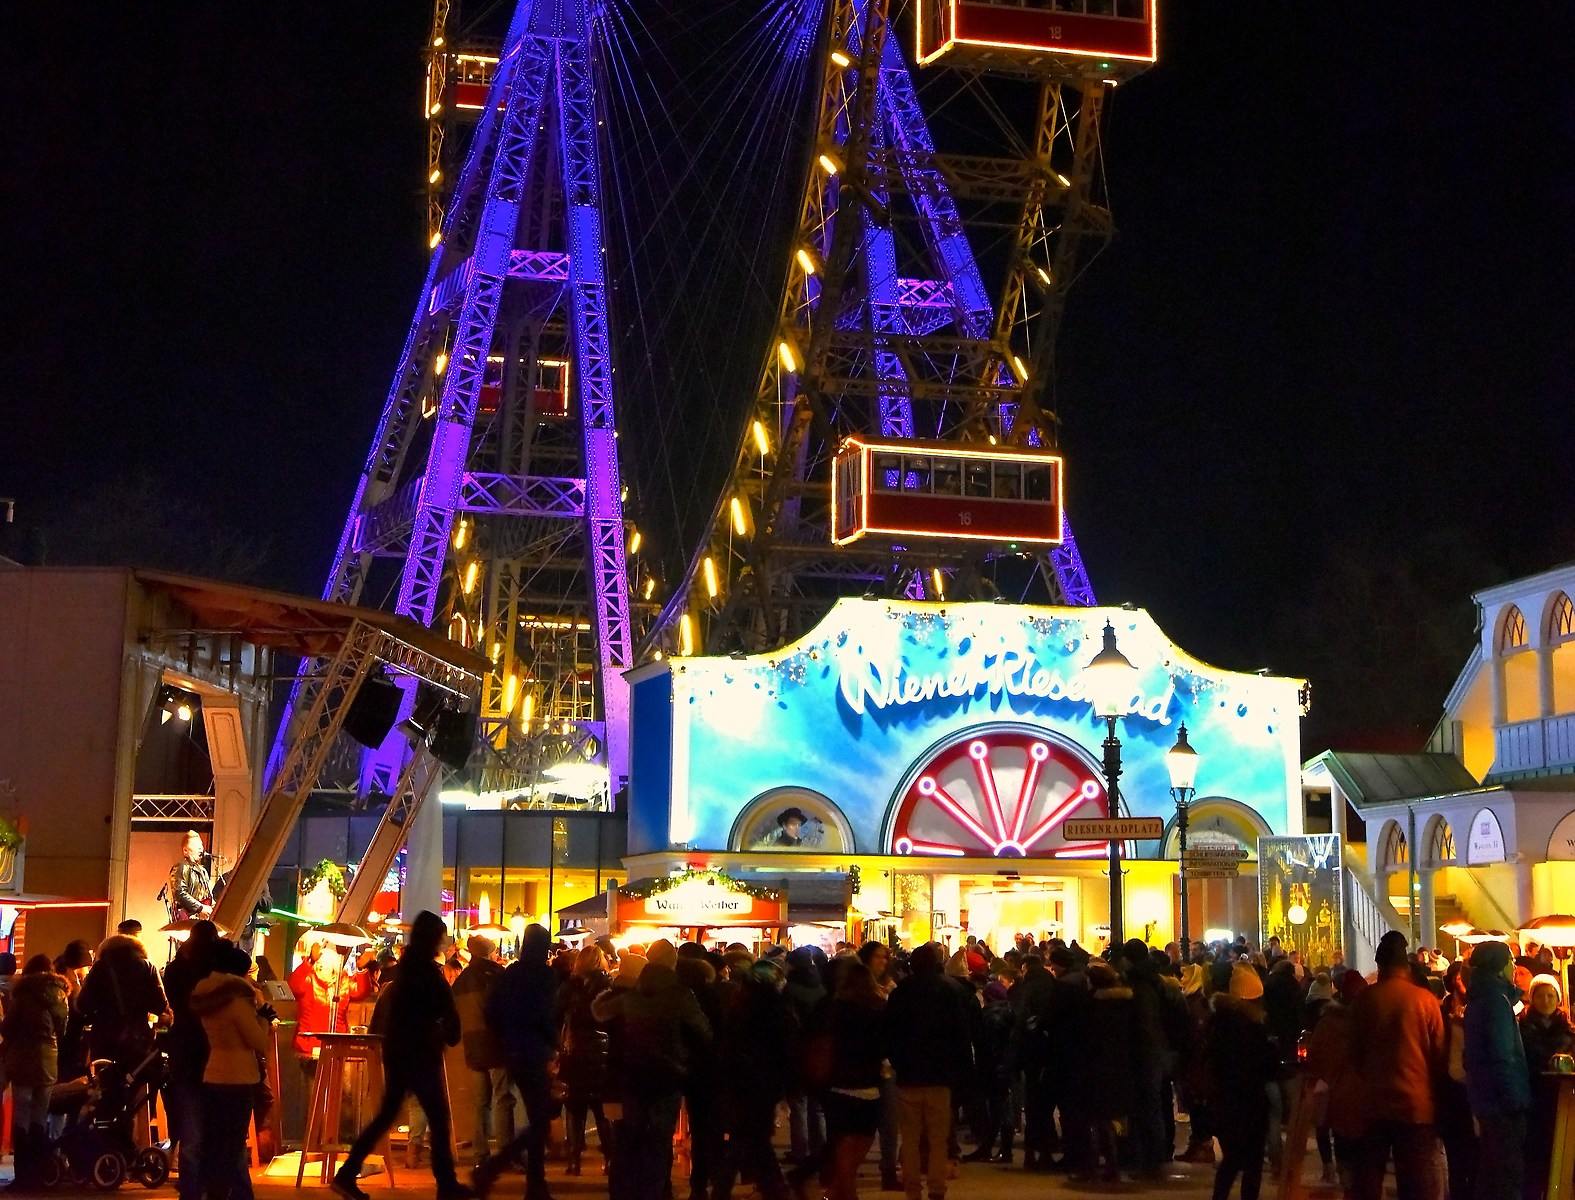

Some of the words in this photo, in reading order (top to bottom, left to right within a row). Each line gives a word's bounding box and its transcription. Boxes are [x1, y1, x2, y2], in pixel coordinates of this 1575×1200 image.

[1048, 25, 1062, 39] 18
[958, 511, 972, 526] 16
[840, 655, 990, 715] Wiener
[984, 648, 1173, 726] Riesead
[1067, 823, 1160, 835] RIESENRADPLATZ
